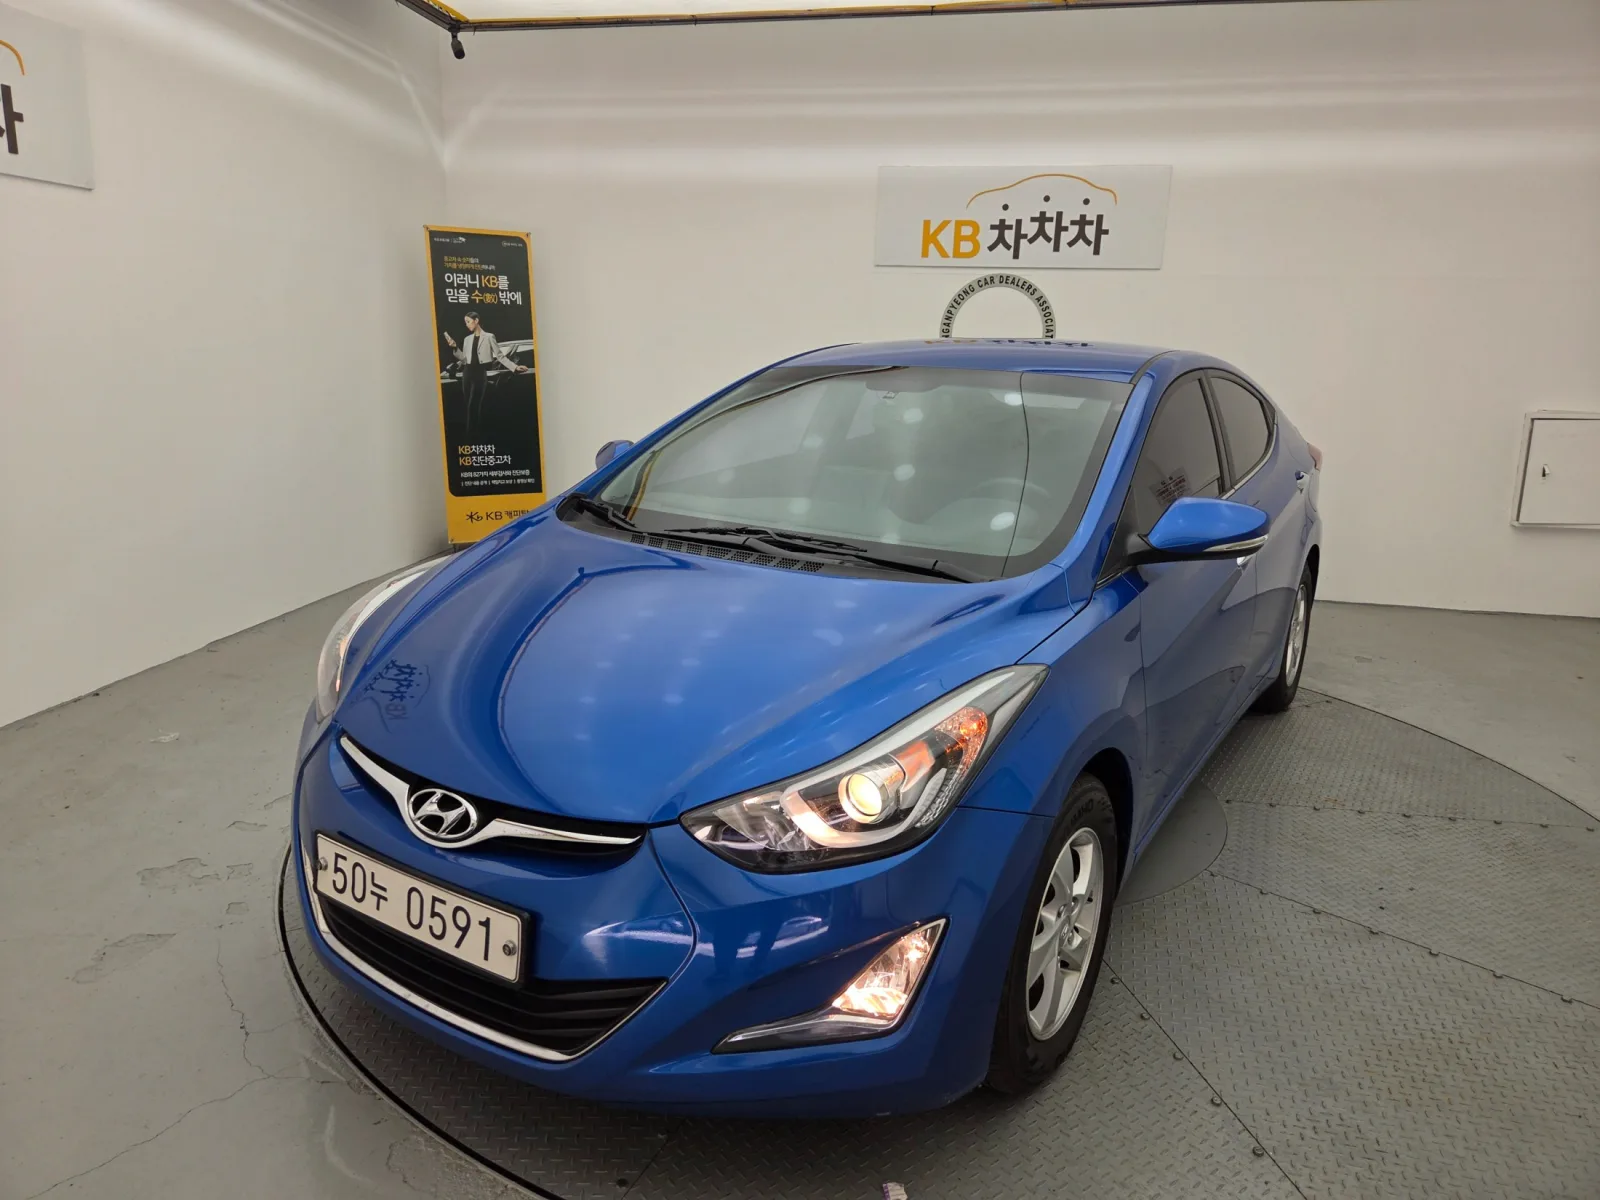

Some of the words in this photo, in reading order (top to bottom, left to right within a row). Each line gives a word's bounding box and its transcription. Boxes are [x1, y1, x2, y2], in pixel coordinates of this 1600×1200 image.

[921, 219, 981, 259] KB
[987, 195, 1109, 260] 차차차
[444, 272, 480, 288] 이러니
[481, 275, 510, 290] KB를
[977, 275, 996, 288] CAR
[998, 275, 1038, 296] DEALERS
[445, 288, 469, 304] 믿을
[499, 291, 522, 305] 밖에
[458, 444, 496, 455] KB차차차
[485, 511, 503, 521] KB
[332, 852, 388, 912] 50누
[406, 886, 491, 961] 0591
